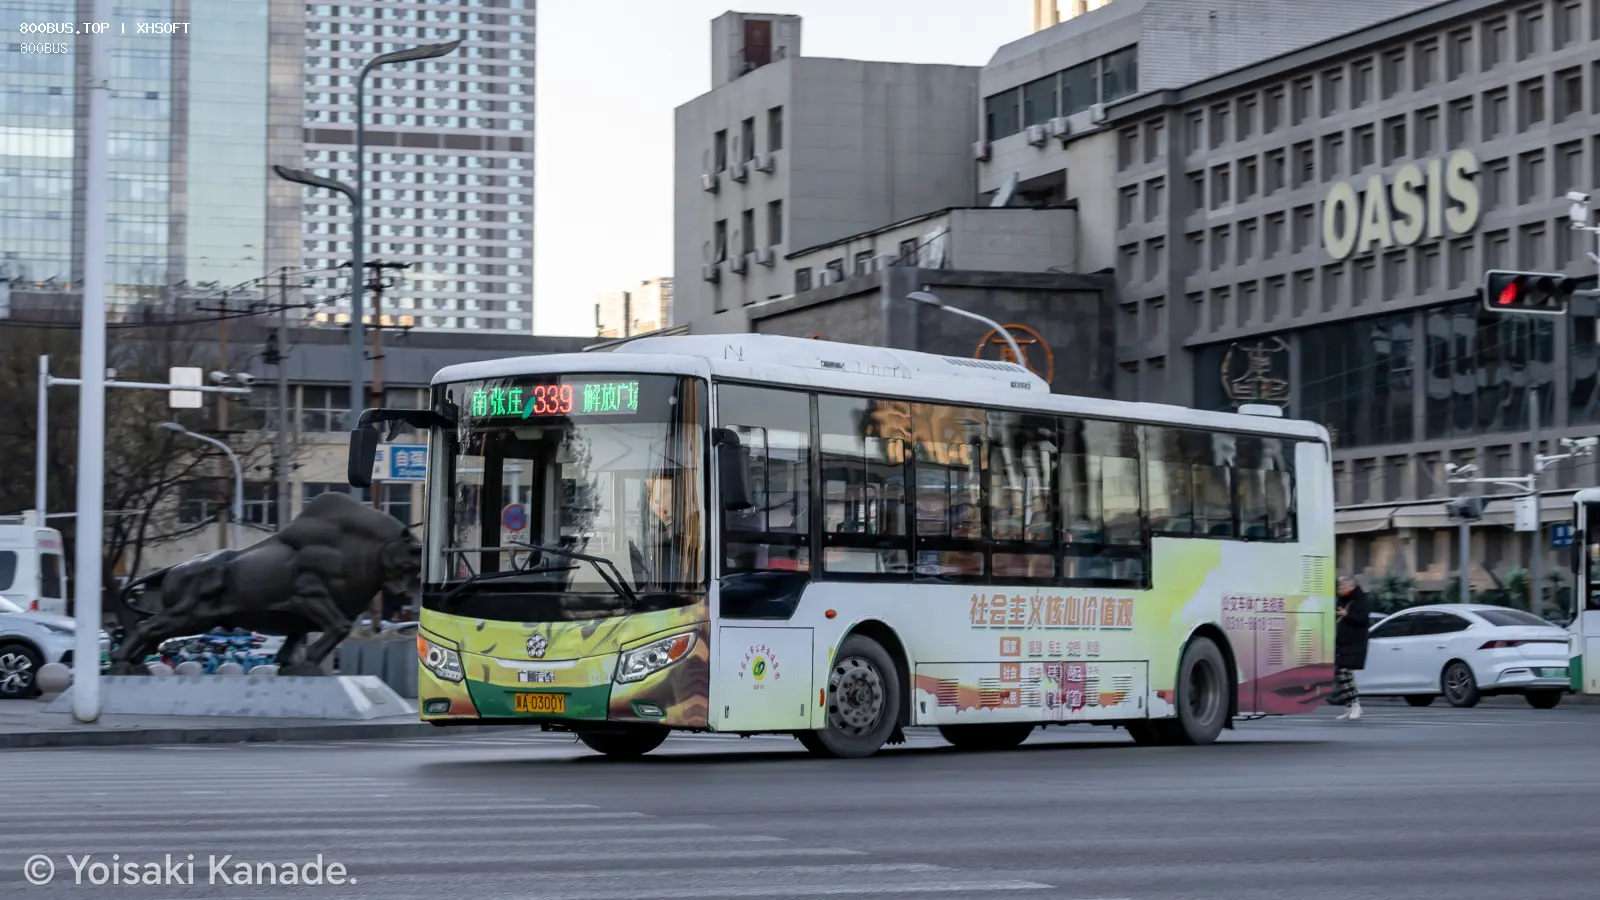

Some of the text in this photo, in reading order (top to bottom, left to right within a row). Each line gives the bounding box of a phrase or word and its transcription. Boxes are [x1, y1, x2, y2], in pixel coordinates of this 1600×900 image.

[1323, 149, 1480, 260] OASIS
[472, 381, 640, 417] 南张庄 339 解放广场
[969, 593, 1134, 628] 社会主义核心价值观
